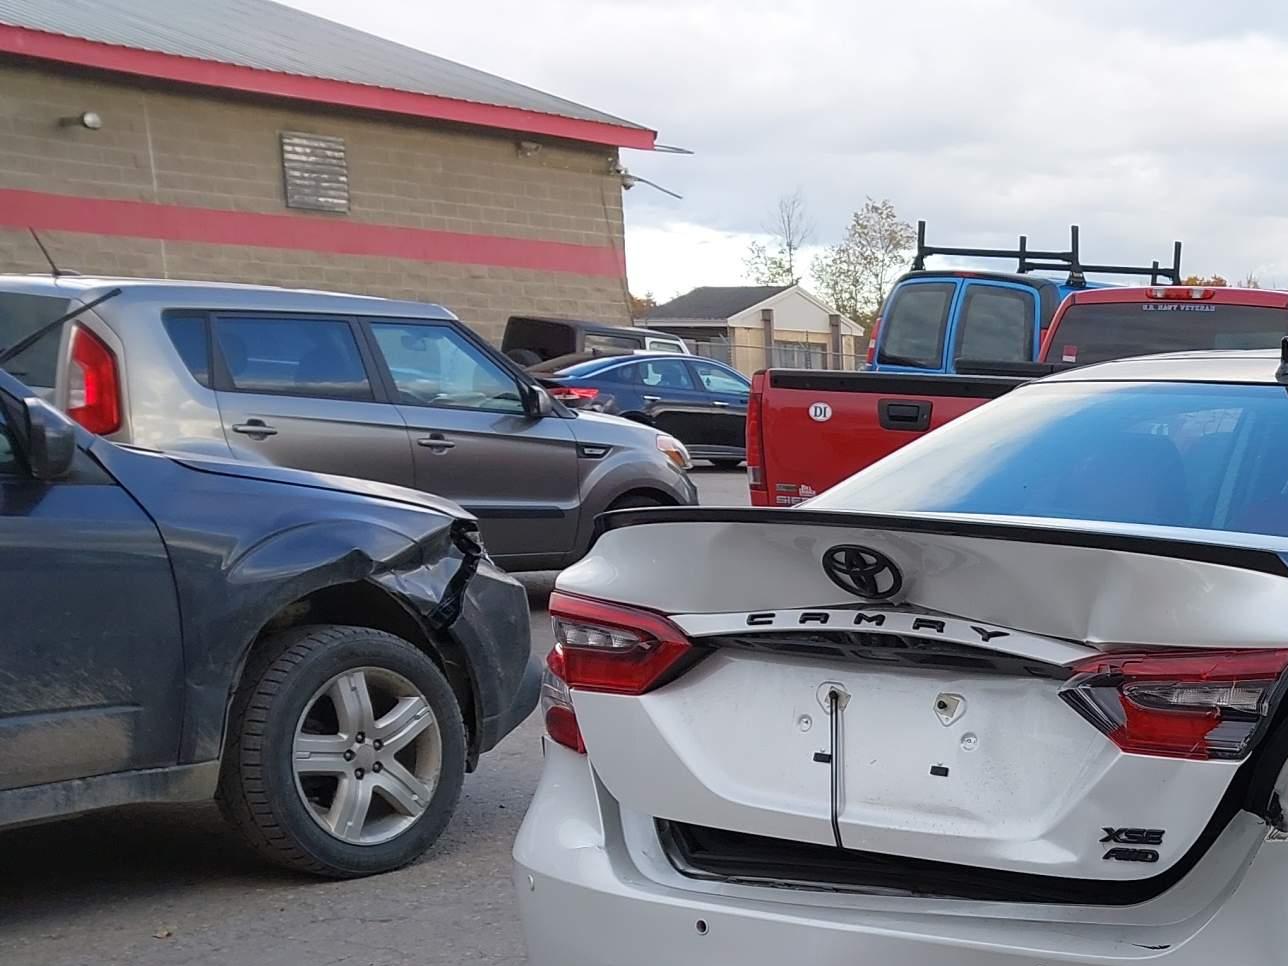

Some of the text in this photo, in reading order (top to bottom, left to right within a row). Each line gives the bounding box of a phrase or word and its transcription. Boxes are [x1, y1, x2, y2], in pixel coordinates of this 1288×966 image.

[814, 406, 827, 417] DI
[745, 612, 1011, 642] CAMRY
[1099, 827, 1166, 845] XSE
